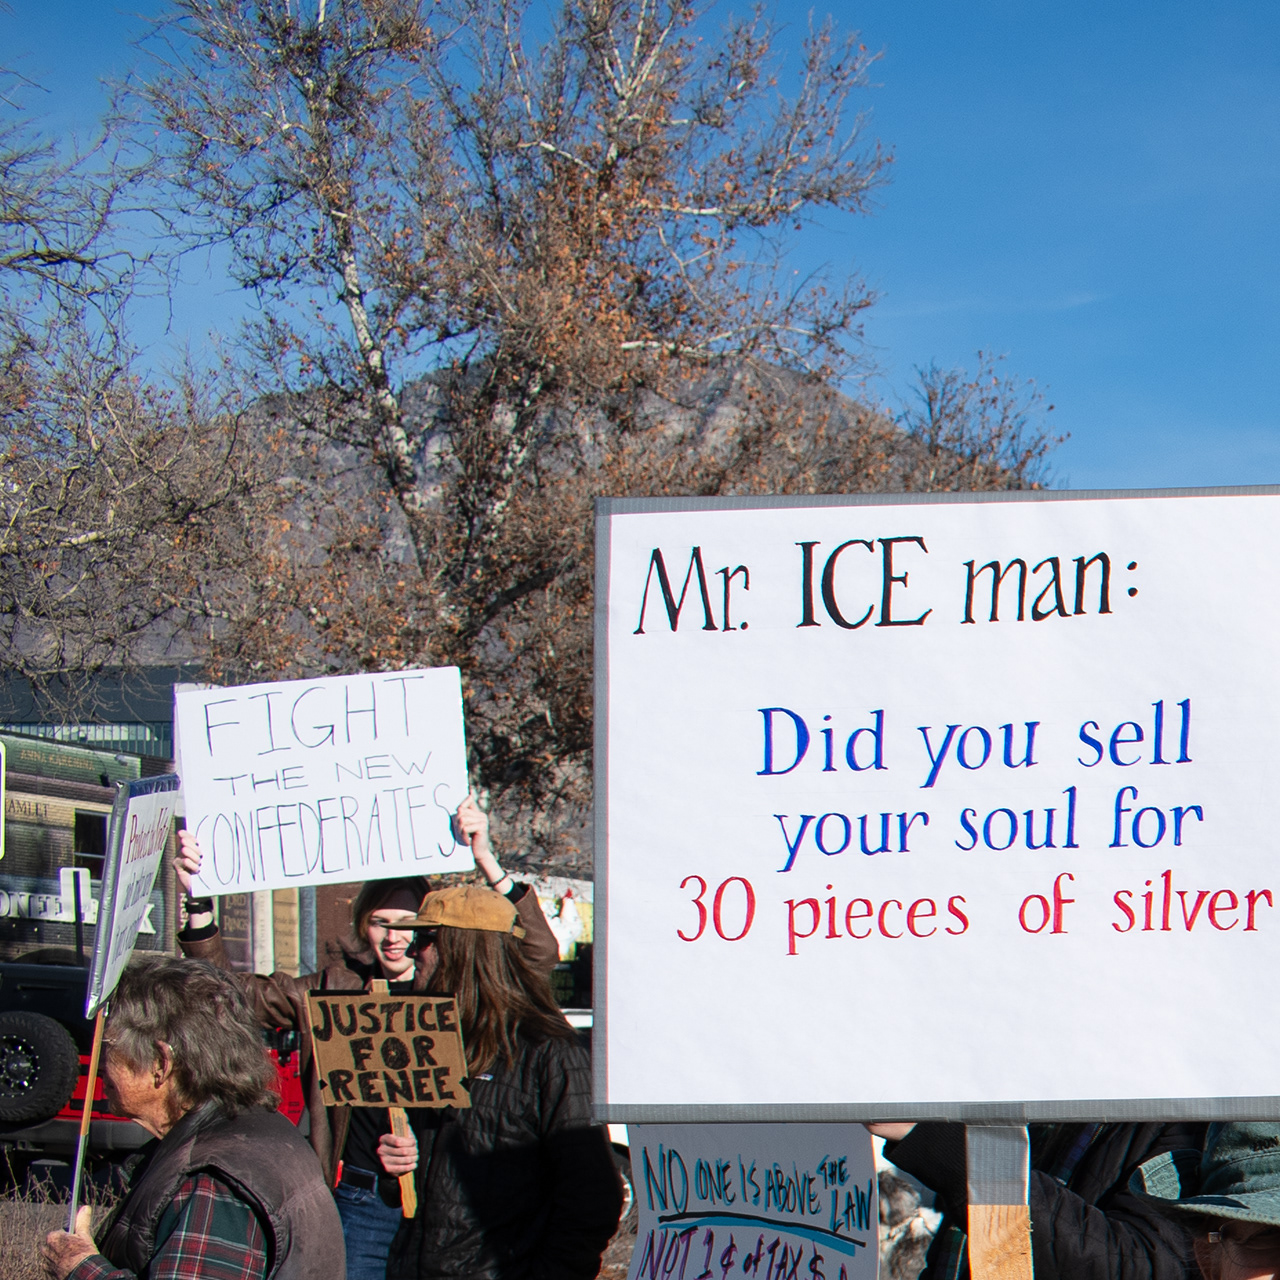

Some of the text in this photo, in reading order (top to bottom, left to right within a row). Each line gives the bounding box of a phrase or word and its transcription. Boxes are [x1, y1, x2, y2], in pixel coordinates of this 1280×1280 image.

[632, 535, 1140, 635] Mr. ICE man:
[204, 676, 425, 757] FIGHT
[755, 698, 1194, 789] Did you sell
[6, 799, 50, 818] AMLET
[212, 751, 433, 796] THE NEW
[194, 782, 457, 890] CONFEDERATES
[773, 785, 1205, 873] your soul for
[676, 874, 757, 943] 30
[786, 881, 971, 956] pieces
[1018, 872, 1076, 936] of
[312, 1000, 457, 1042] JUSTICE
[349, 1035, 438, 1071] FOR
[328, 1066, 456, 1103] RENEE
[642, 1144, 873, 1233] NO ONE IS ABOVE THE LAW
[743, 1233, 765, 1279] of
